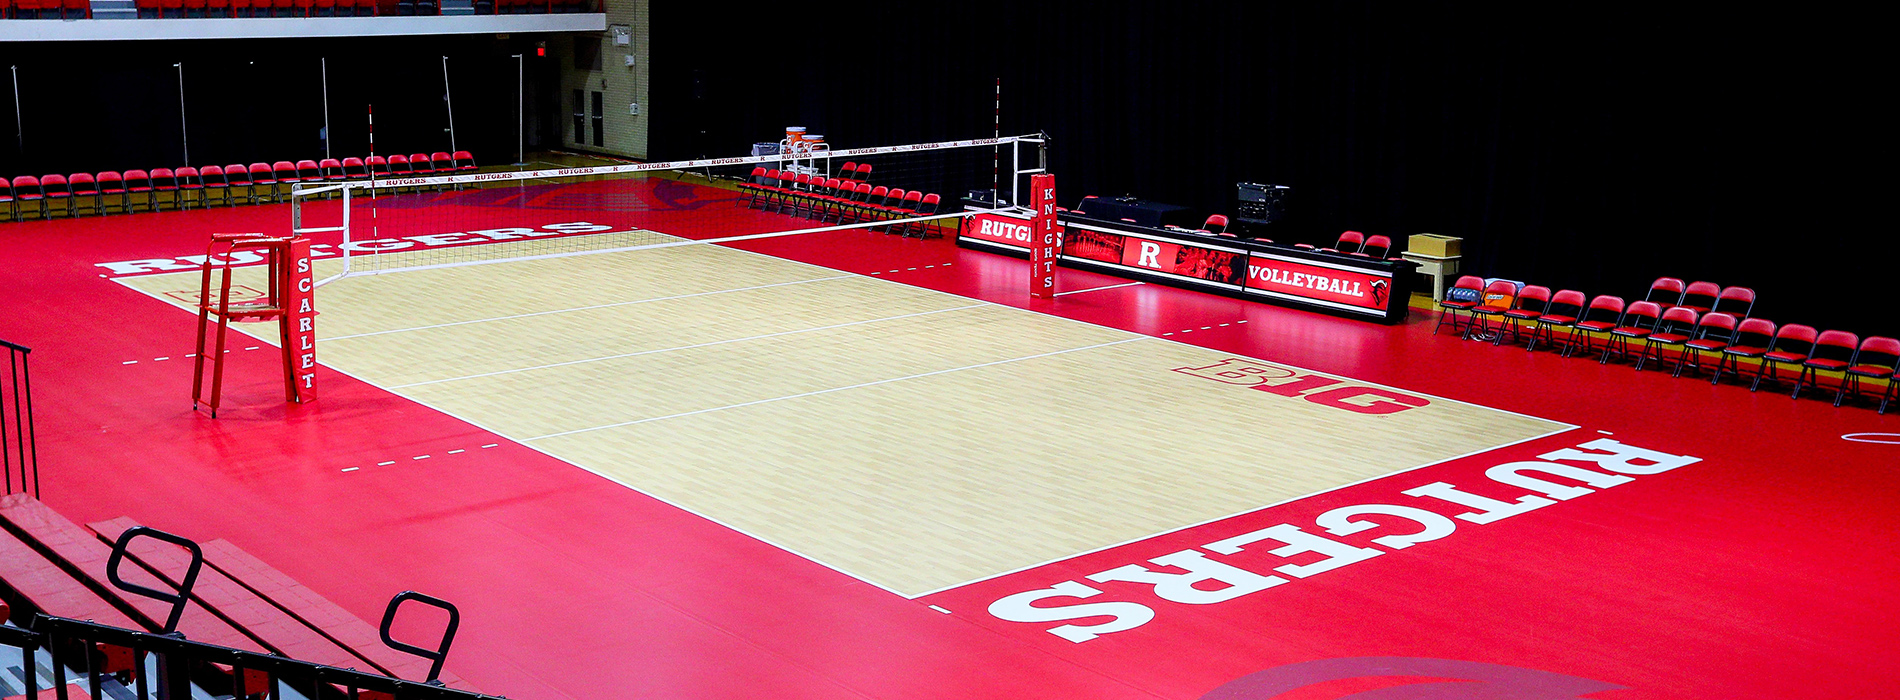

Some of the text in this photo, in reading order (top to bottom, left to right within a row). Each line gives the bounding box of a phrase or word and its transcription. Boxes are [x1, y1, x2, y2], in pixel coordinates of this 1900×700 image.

[386, 177, 427, 186] RUTGERS
[474, 172, 513, 181] RUTGERS
[558, 167, 594, 175] RUTGERS
[636, 162, 671, 170] RUTGERS
[711, 157, 744, 165] RUTGERS
[980, 218, 1063, 248] RUTGS
[1043, 188, 1055, 288] KNIGHTS
[1137, 241, 1162, 269] R
[1248, 265, 1364, 298] VOLLEYBALL
[297, 257, 315, 389] SCARLET
[987, 437, 1703, 644] RUTGERS
